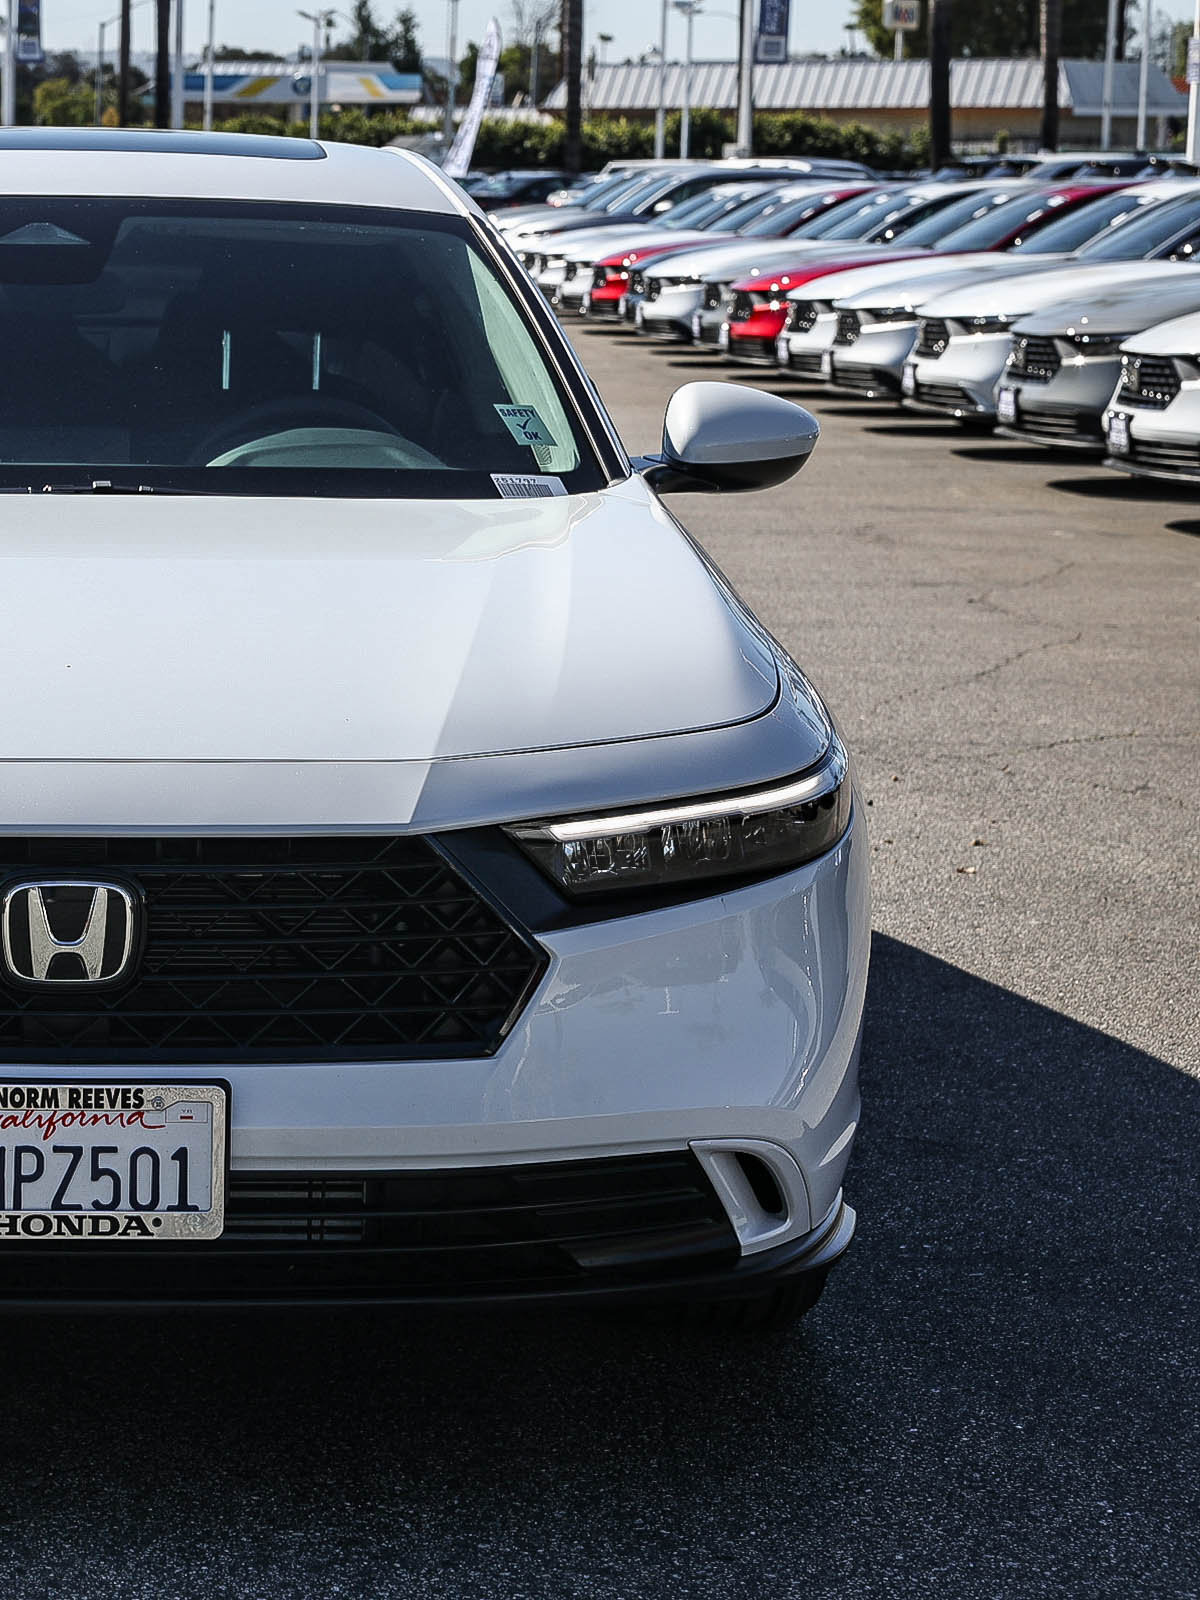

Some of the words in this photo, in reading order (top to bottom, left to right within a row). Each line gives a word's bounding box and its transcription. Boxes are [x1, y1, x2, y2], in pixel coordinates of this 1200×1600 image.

[499, 408, 536, 418] SAFETY
[523, 430, 542, 441] OK
[68, 1087, 145, 1109] REEVES
